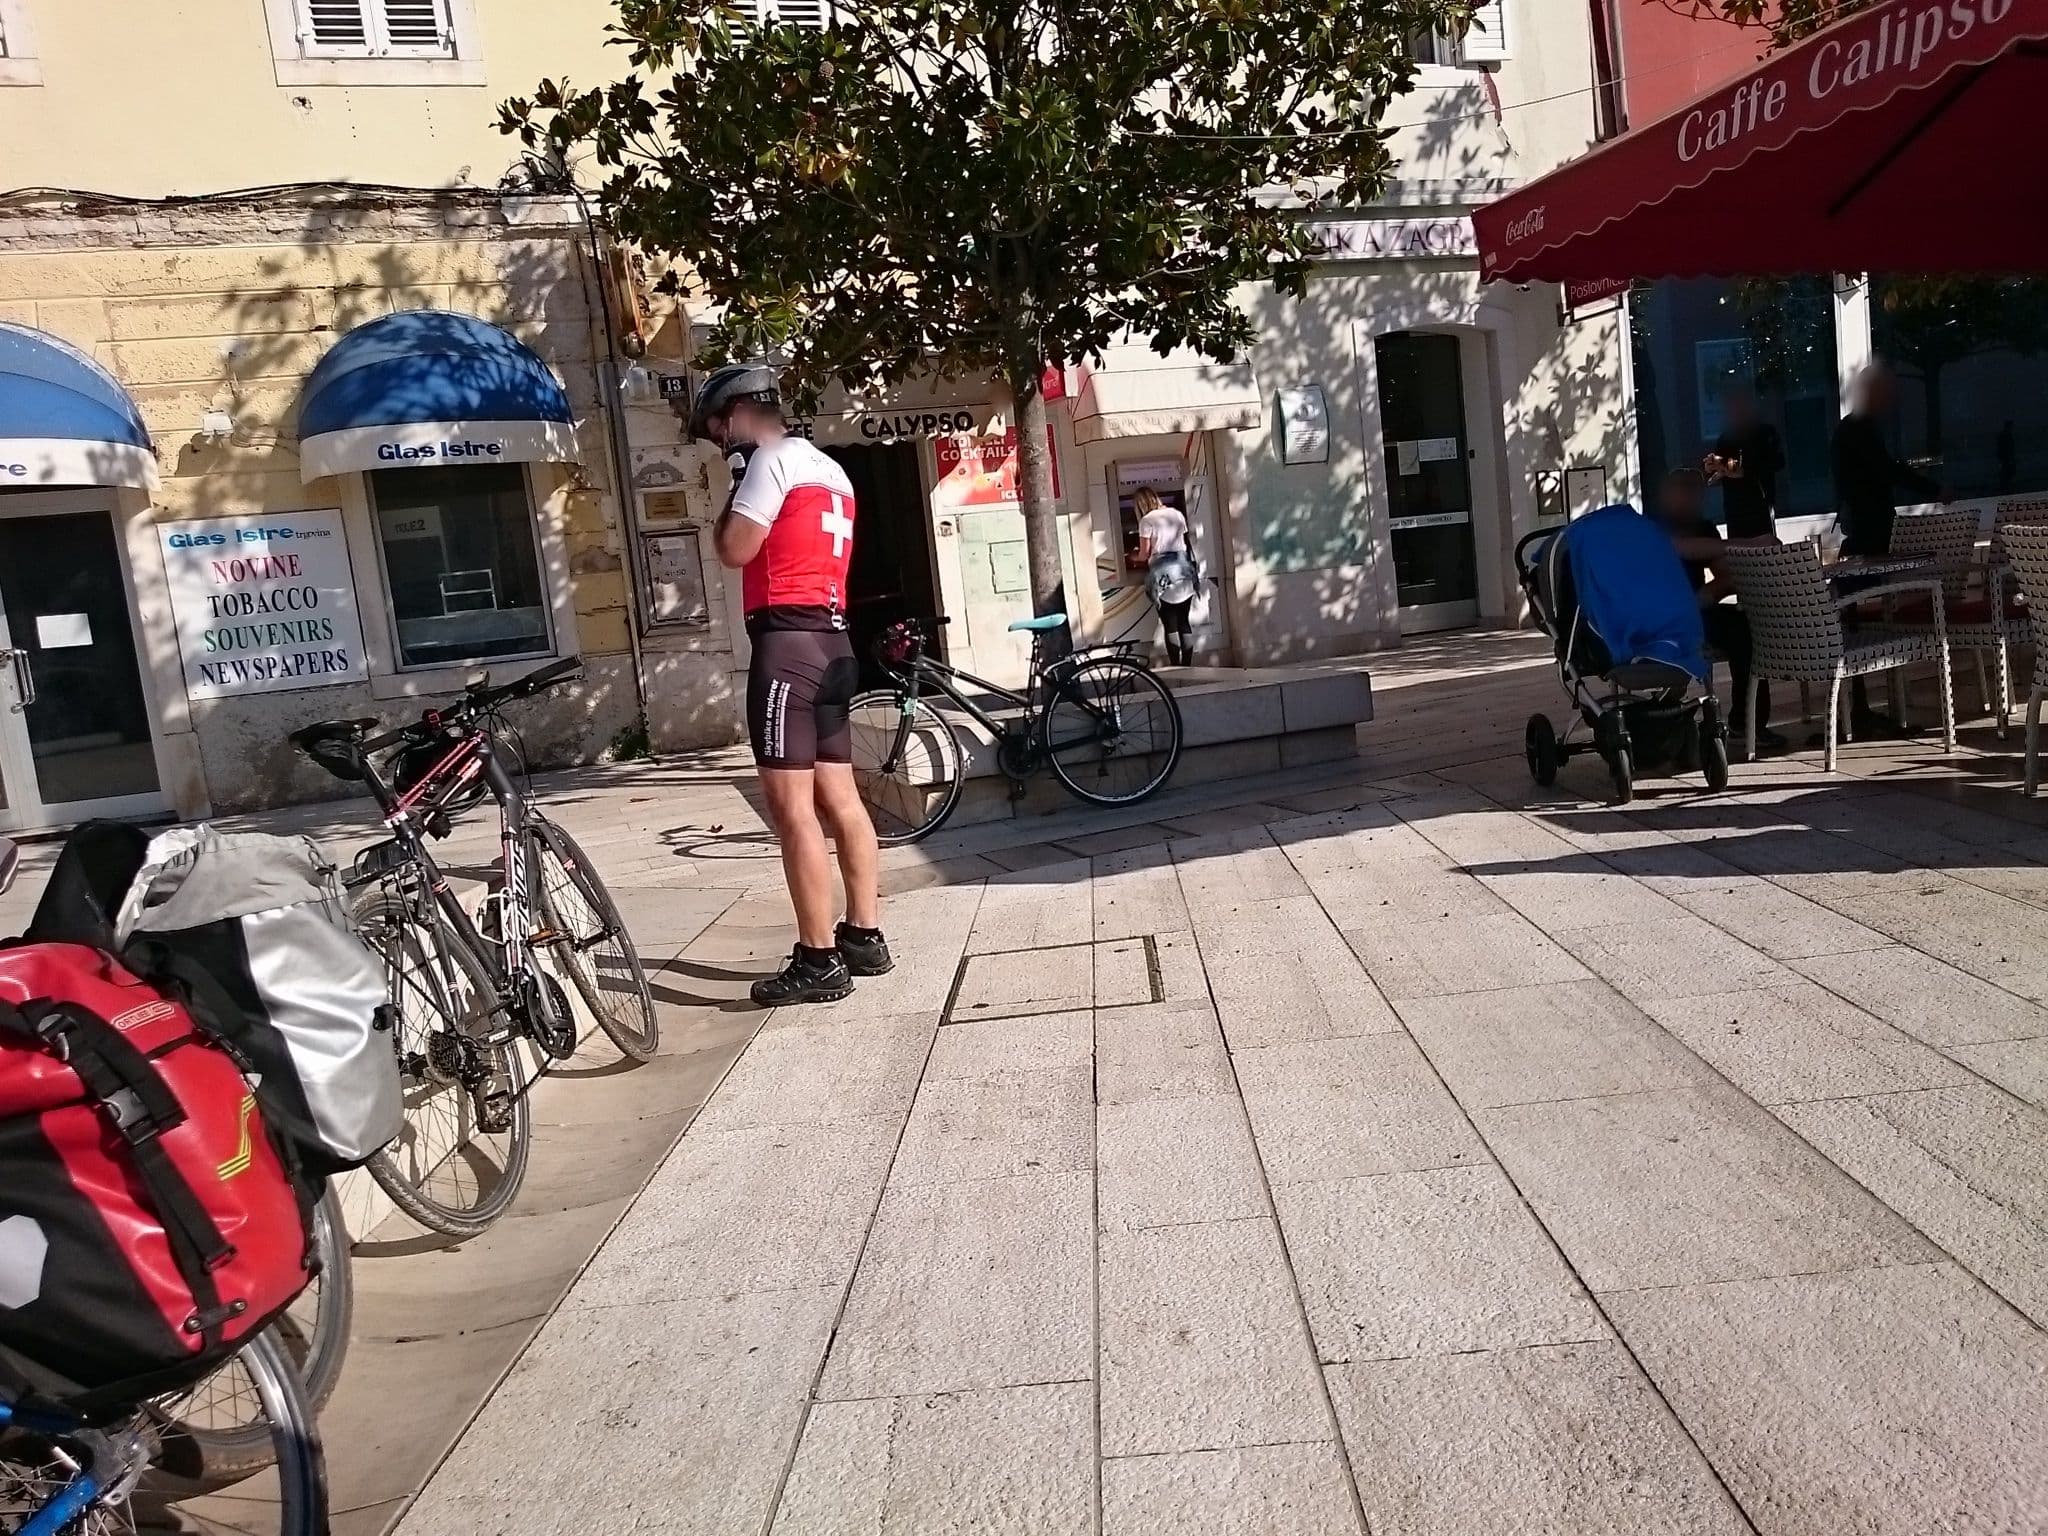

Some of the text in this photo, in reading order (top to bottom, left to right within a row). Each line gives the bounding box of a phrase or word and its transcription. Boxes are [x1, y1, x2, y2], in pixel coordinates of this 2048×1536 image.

[1677, 77, 1787, 162] Caffe
[1387, 222, 1466, 253] ZAGR
[666, 379, 682, 392] 13
[860, 411, 974, 439] CALYPSO
[378, 441, 501, 460] Glas Istre
[940, 445, 1017, 461] COCKTAILS
[168, 533, 226, 549] Glas
[235, 527, 294, 543] Istre
[212, 554, 303, 584] NOVINE
[207, 586, 318, 618] TOBACCO
[204, 617, 334, 652] SOUVENIRS
[199, 648, 349, 687] NEWSPAPERS
